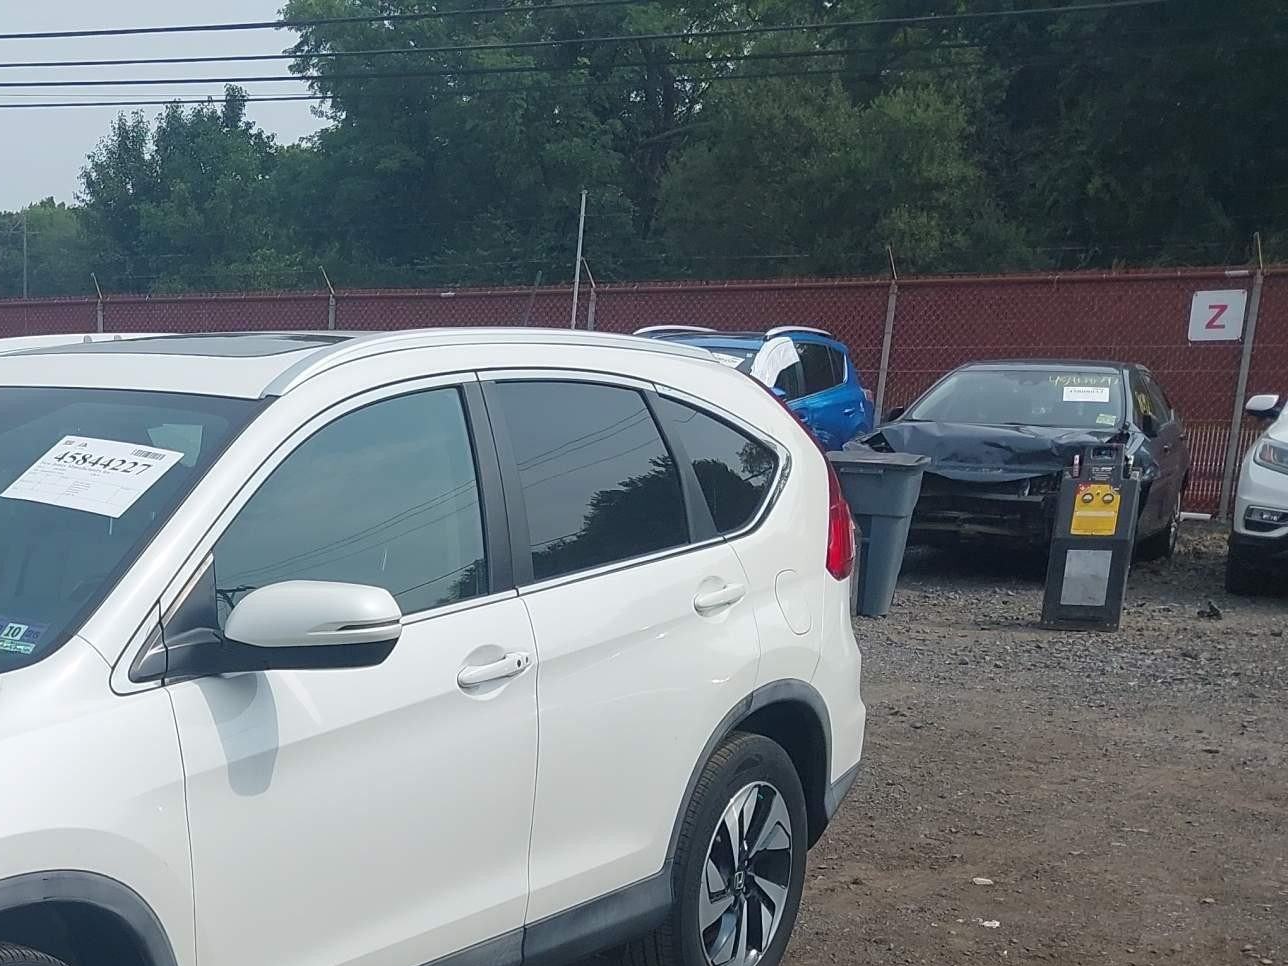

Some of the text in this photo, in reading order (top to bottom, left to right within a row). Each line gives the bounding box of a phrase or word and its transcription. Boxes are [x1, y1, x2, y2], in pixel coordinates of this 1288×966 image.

[1205, 305, 1228, 329] Z
[54, 451, 152, 475] 45844227
[4, 626, 22, 638] 10
